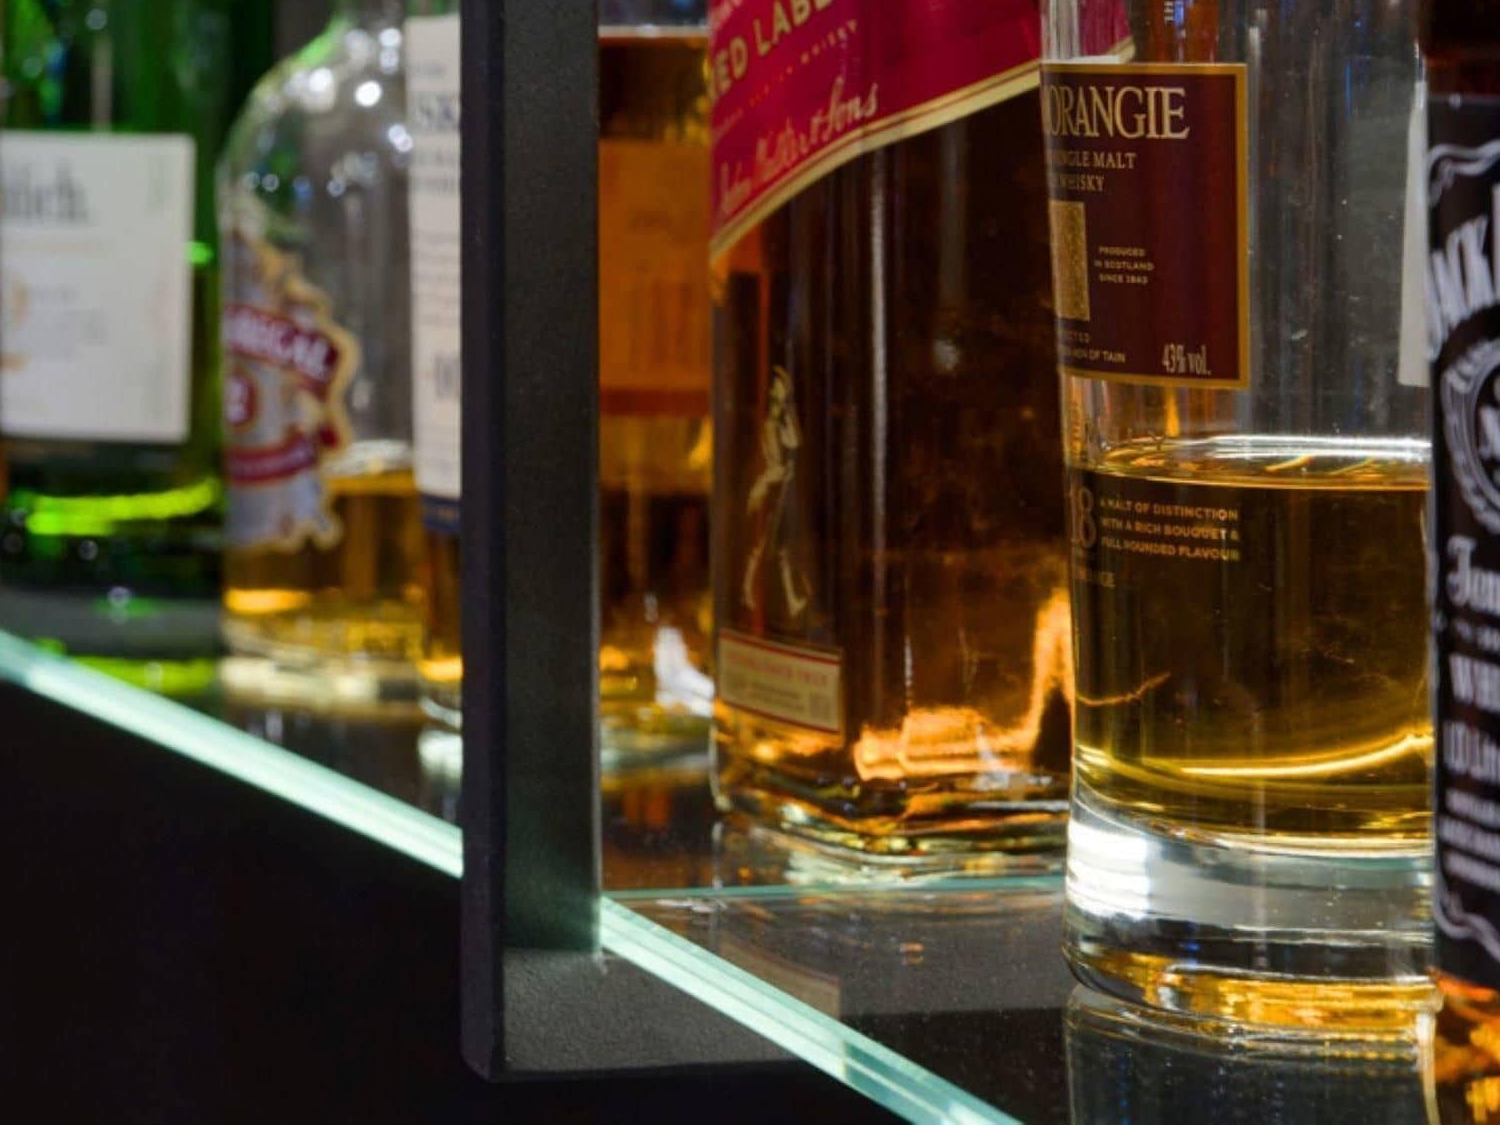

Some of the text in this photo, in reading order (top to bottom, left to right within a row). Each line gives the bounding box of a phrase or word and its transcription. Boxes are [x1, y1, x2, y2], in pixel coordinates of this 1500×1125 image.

[1092, 151, 1137, 169] MALT
[1162, 343, 1185, 374] 43%
[1134, 502, 1149, 513] OF
[1152, 503, 1239, 522] DISTINCTION
[1134, 521, 1162, 535] RICH
[1164, 525, 1228, 541] BOUQUET
[1178, 544, 1240, 562] FLAVOUR
